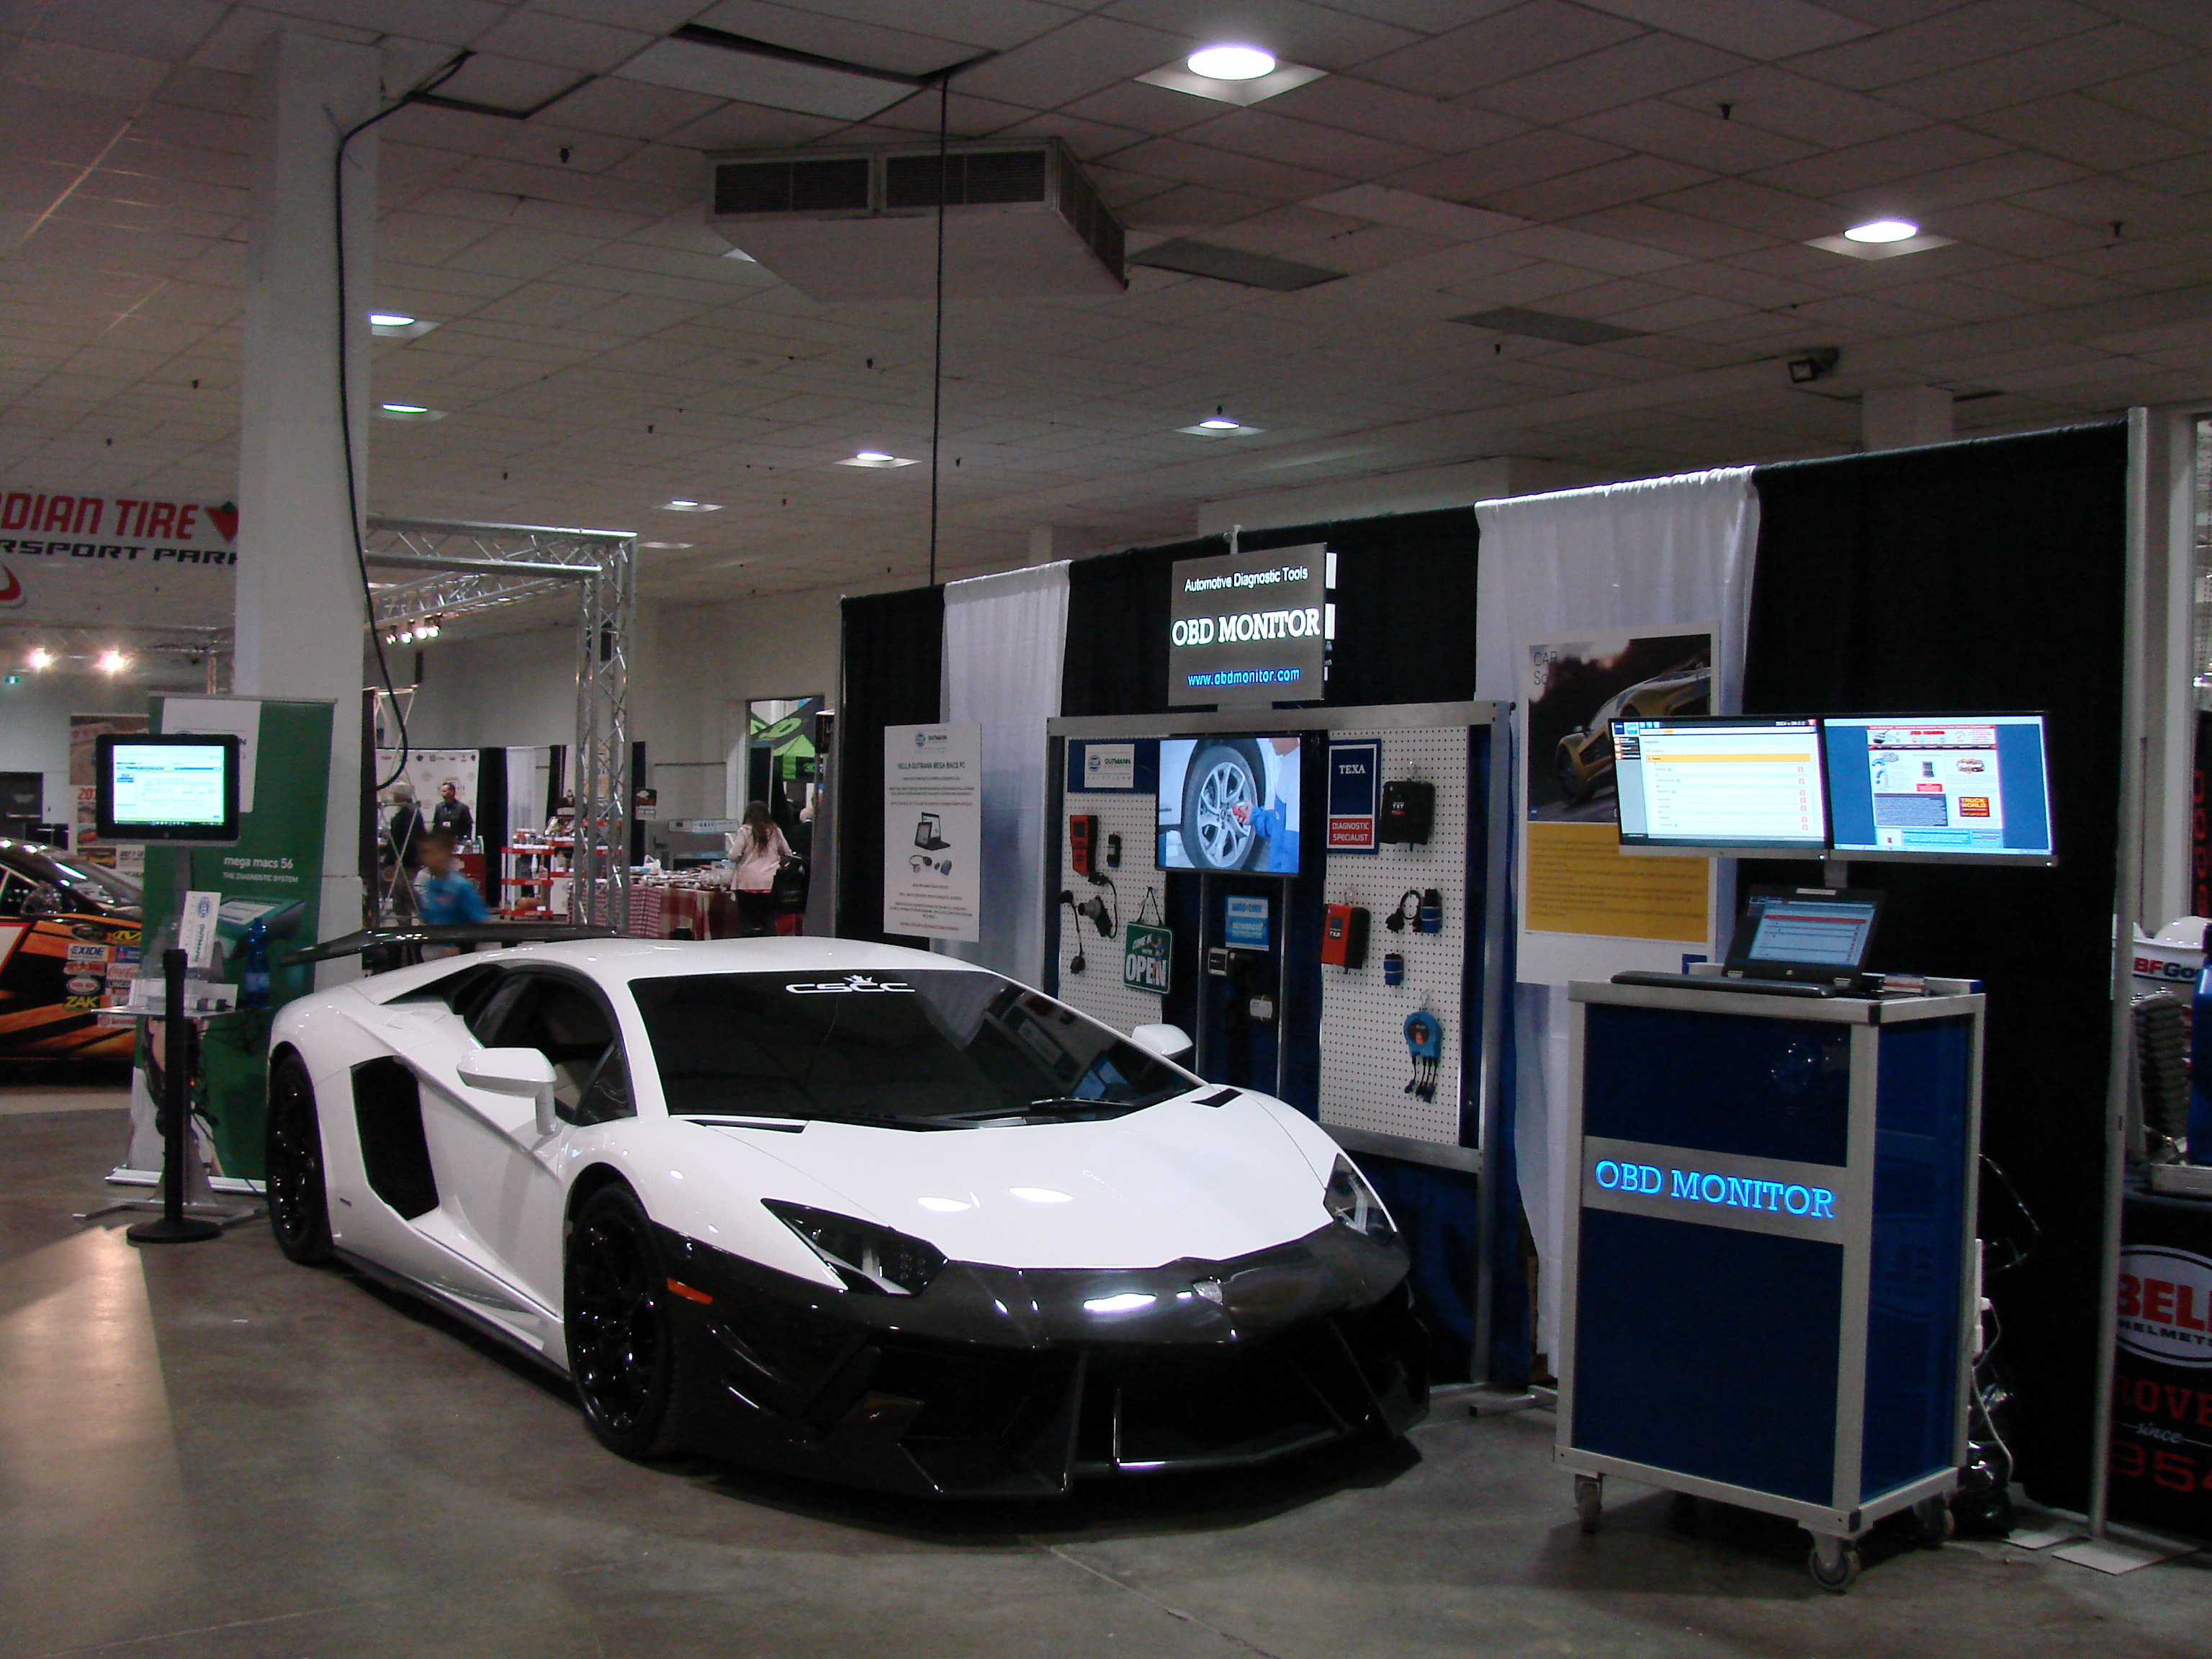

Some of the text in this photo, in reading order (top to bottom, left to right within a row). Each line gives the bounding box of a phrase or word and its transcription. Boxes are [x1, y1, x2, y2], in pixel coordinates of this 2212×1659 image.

[0, 492, 199, 540] DIAN TIRE
[1184, 565, 1308, 592] Automotive Diagnostic Tools
[1172, 608, 1321, 646] OBD MONITOR
[1187, 667, 1300, 686] www.obdmonitor.com
[1339, 764, 1366, 775] TEXA
[1331, 822, 1369, 830] DIAGNOSTIC
[1332, 833, 1369, 842] SPECIALIST
[224, 857, 294, 869] mega macs 56
[71, 945, 105, 956] EXIDE
[1125, 953, 1166, 986] OPEN
[1594, 1159, 1835, 1220] OBD MONITOR
[2117, 1272, 2212, 1334] BEL
